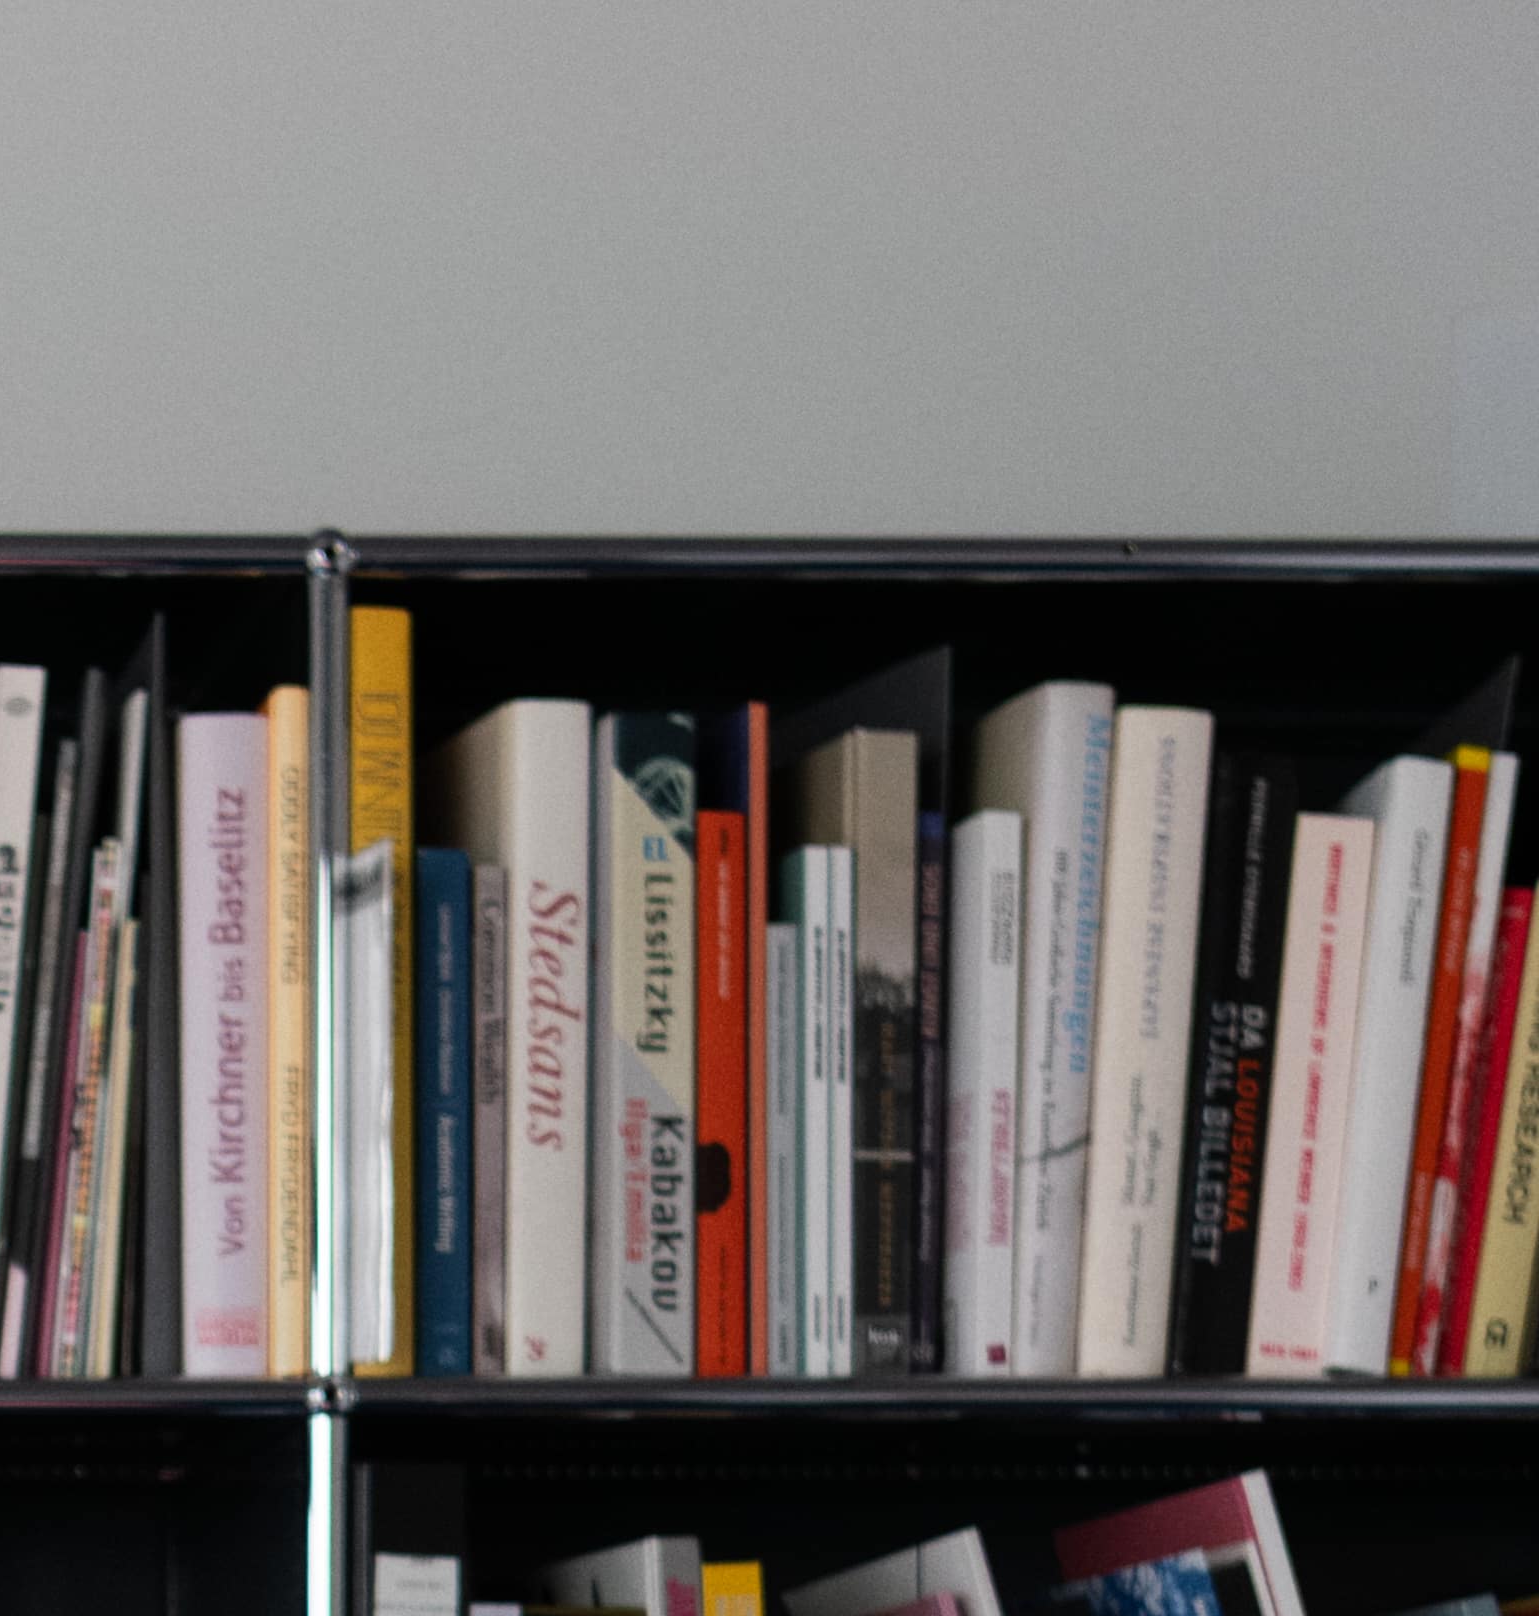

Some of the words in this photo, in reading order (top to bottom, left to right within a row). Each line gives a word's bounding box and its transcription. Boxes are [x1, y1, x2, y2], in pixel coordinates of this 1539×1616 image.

[211, 789, 247, 944] Baselitz
[1066, 714, 1109, 1074] Meisterzeichnungen
[526, 881, 582, 1150] Stedsans
[638, 874, 674, 1054] Lissitzky
[212, 1014, 247, 1183] Kirchner
[1225, 1060, 1259, 1232] LOUISIANA
[217, 1195, 245, 1257] Von
[652, 1114, 685, 1314] Kabakov
